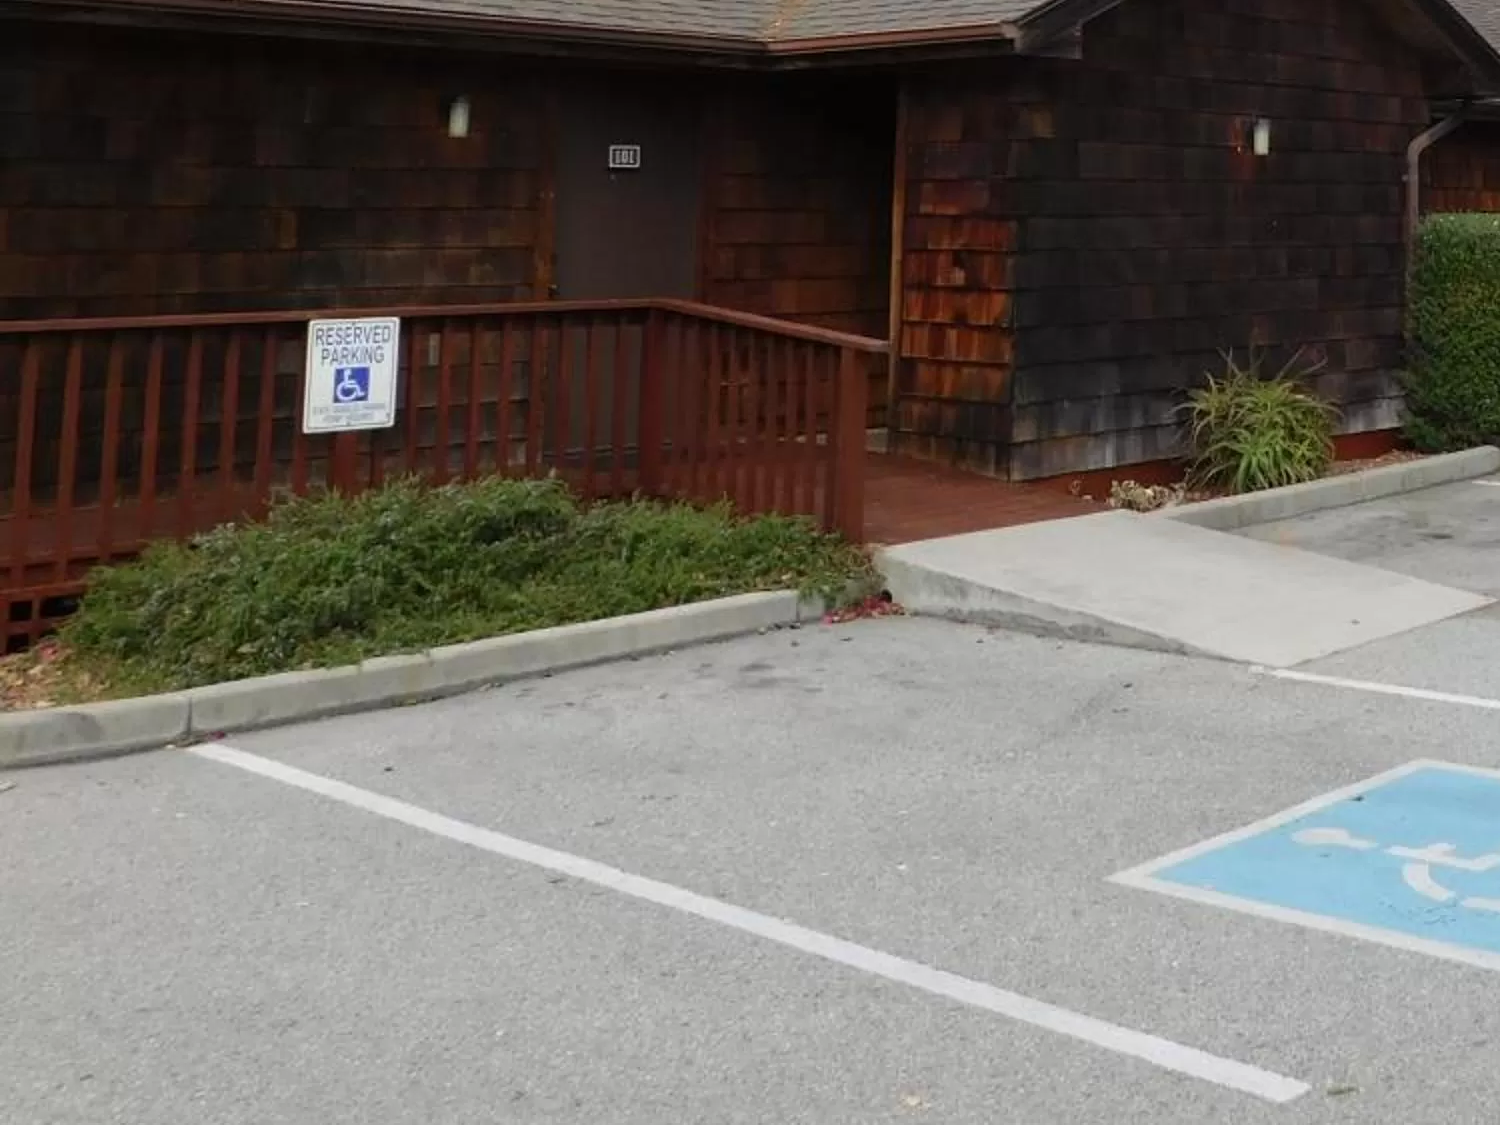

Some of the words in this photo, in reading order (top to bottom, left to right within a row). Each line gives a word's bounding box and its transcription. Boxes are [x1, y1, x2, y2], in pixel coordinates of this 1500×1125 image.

[615, 150, 634, 164] 101
[315, 325, 391, 346] RESERVED
[321, 345, 385, 366] PARKING
